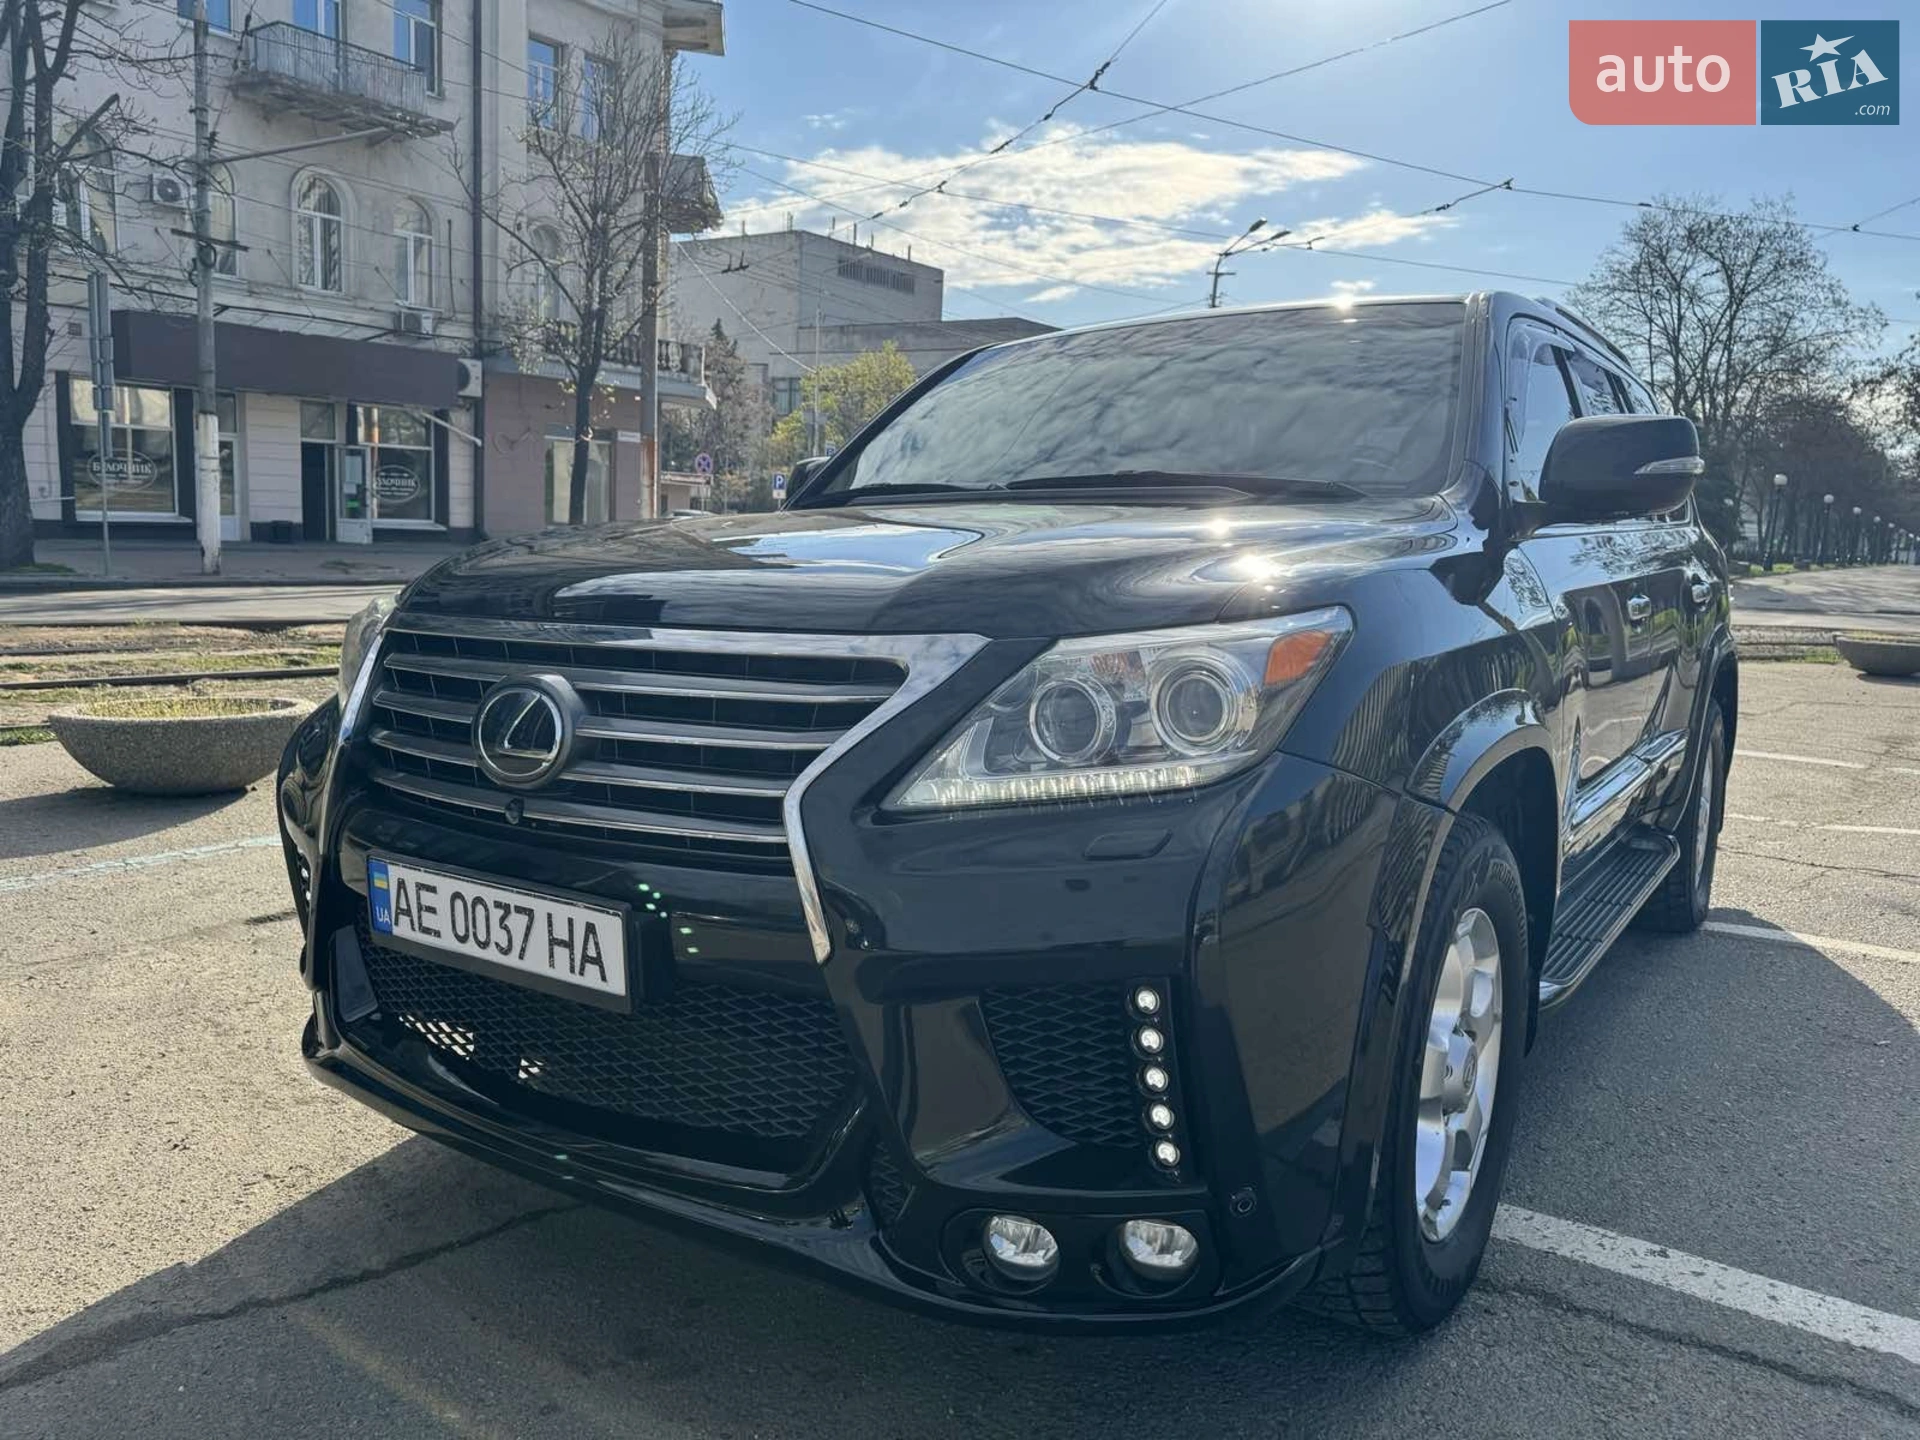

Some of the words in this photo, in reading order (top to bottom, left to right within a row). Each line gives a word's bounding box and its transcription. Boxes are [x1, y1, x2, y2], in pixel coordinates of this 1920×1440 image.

[93, 461, 151, 473] БЛОЧИК
[374, 478, 416, 487] УЛОЧНИК
[375, 905, 392, 925] UA
[393, 877, 442, 939] AE
[449, 891, 535, 960] 0037
[546, 912, 608, 983] HA
